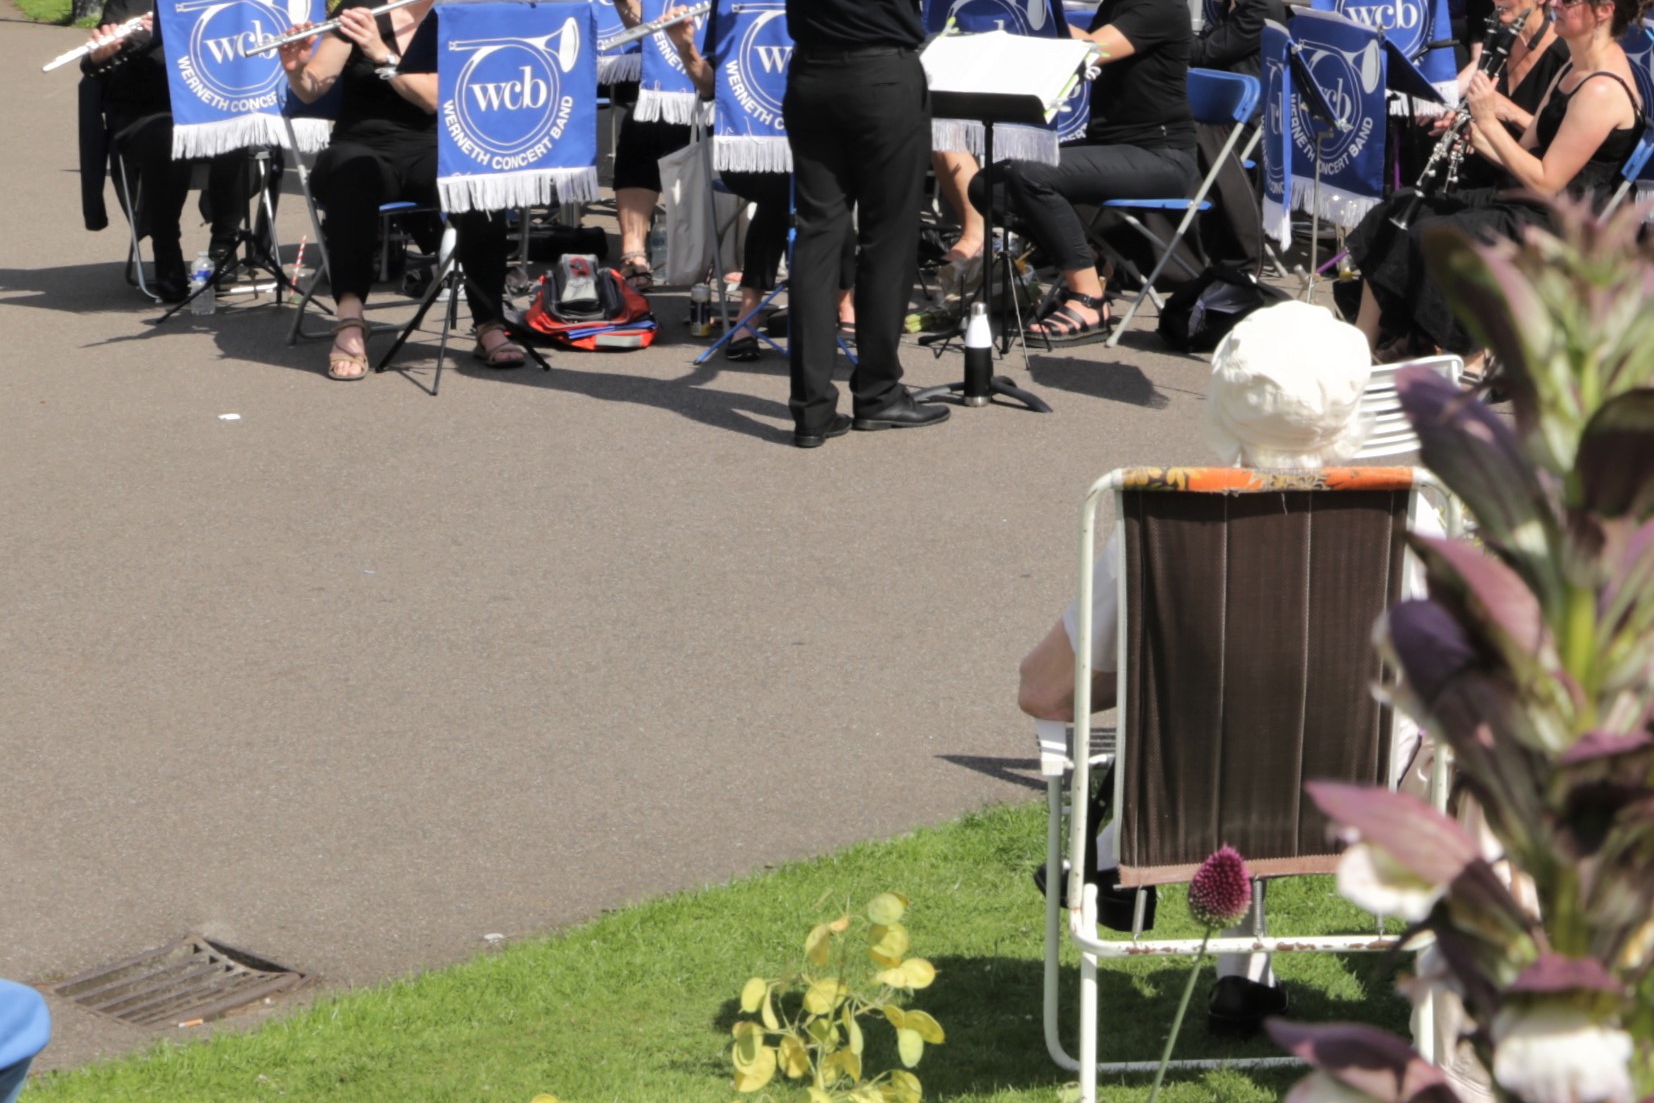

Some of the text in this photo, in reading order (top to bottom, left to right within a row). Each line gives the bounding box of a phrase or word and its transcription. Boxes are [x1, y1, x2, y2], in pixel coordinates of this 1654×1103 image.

[177, 55, 229, 111] WERNETH
[468, 65, 547, 112] wcb
[726, 60, 773, 126] WERNETH
[442, 95, 573, 170] WERNETH CONCERT BAND
[1348, 117, 1374, 157] BAND
